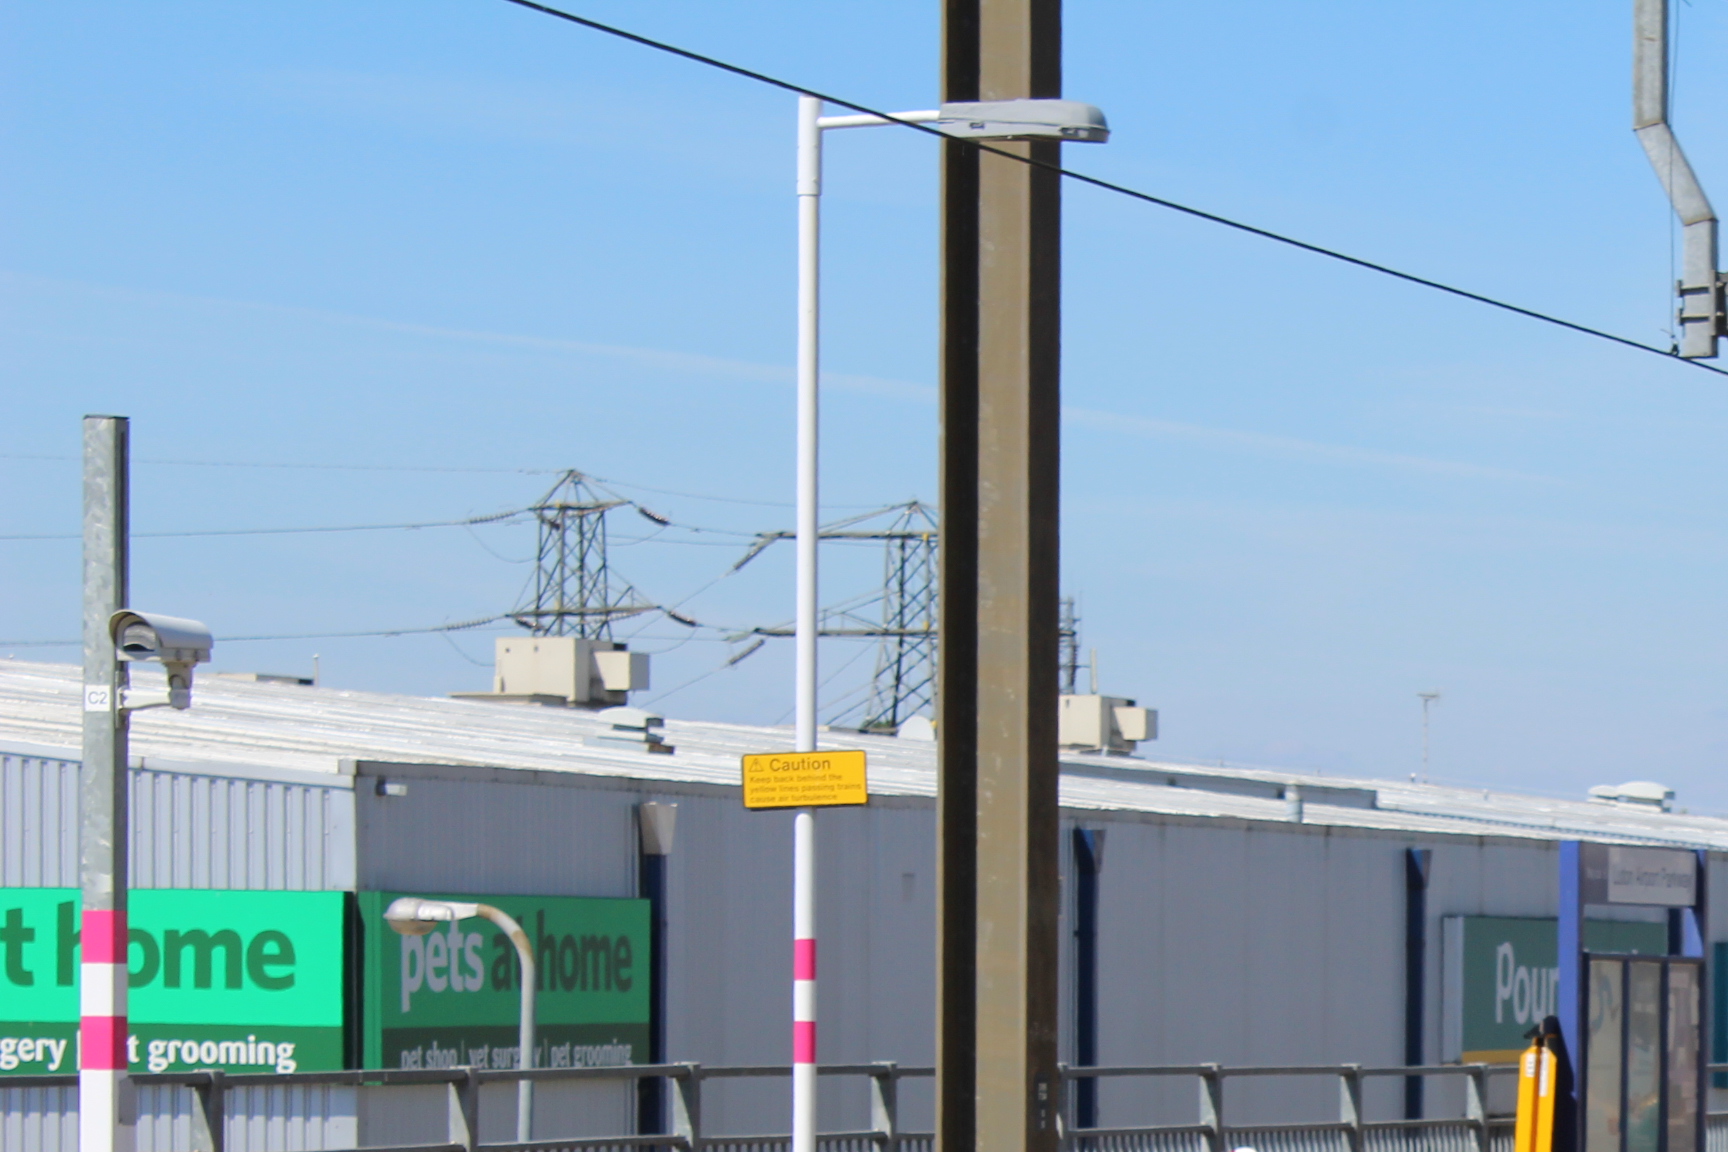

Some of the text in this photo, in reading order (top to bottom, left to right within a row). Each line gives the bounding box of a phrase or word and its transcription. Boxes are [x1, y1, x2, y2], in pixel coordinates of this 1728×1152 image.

[87, 690, 108, 705] C2
[769, 757, 831, 772] Caution
[749, 773, 843, 784] Keep back behind the
[749, 785, 777, 795] yellow
[779, 784, 799, 792] lines
[801, 784, 835, 793] passing
[791, 793, 838, 801] turbulence
[401, 920, 485, 1013] pets
[537, 910, 633, 992] home
[148, 1035, 297, 1075] grooming
[400, 1045, 422, 1068] pet
[426, 1040, 458, 1068] shop
[468, 1044, 489, 1067] vet
[551, 1042, 571, 1067] pet
[573, 1038, 633, 1067] grooming
